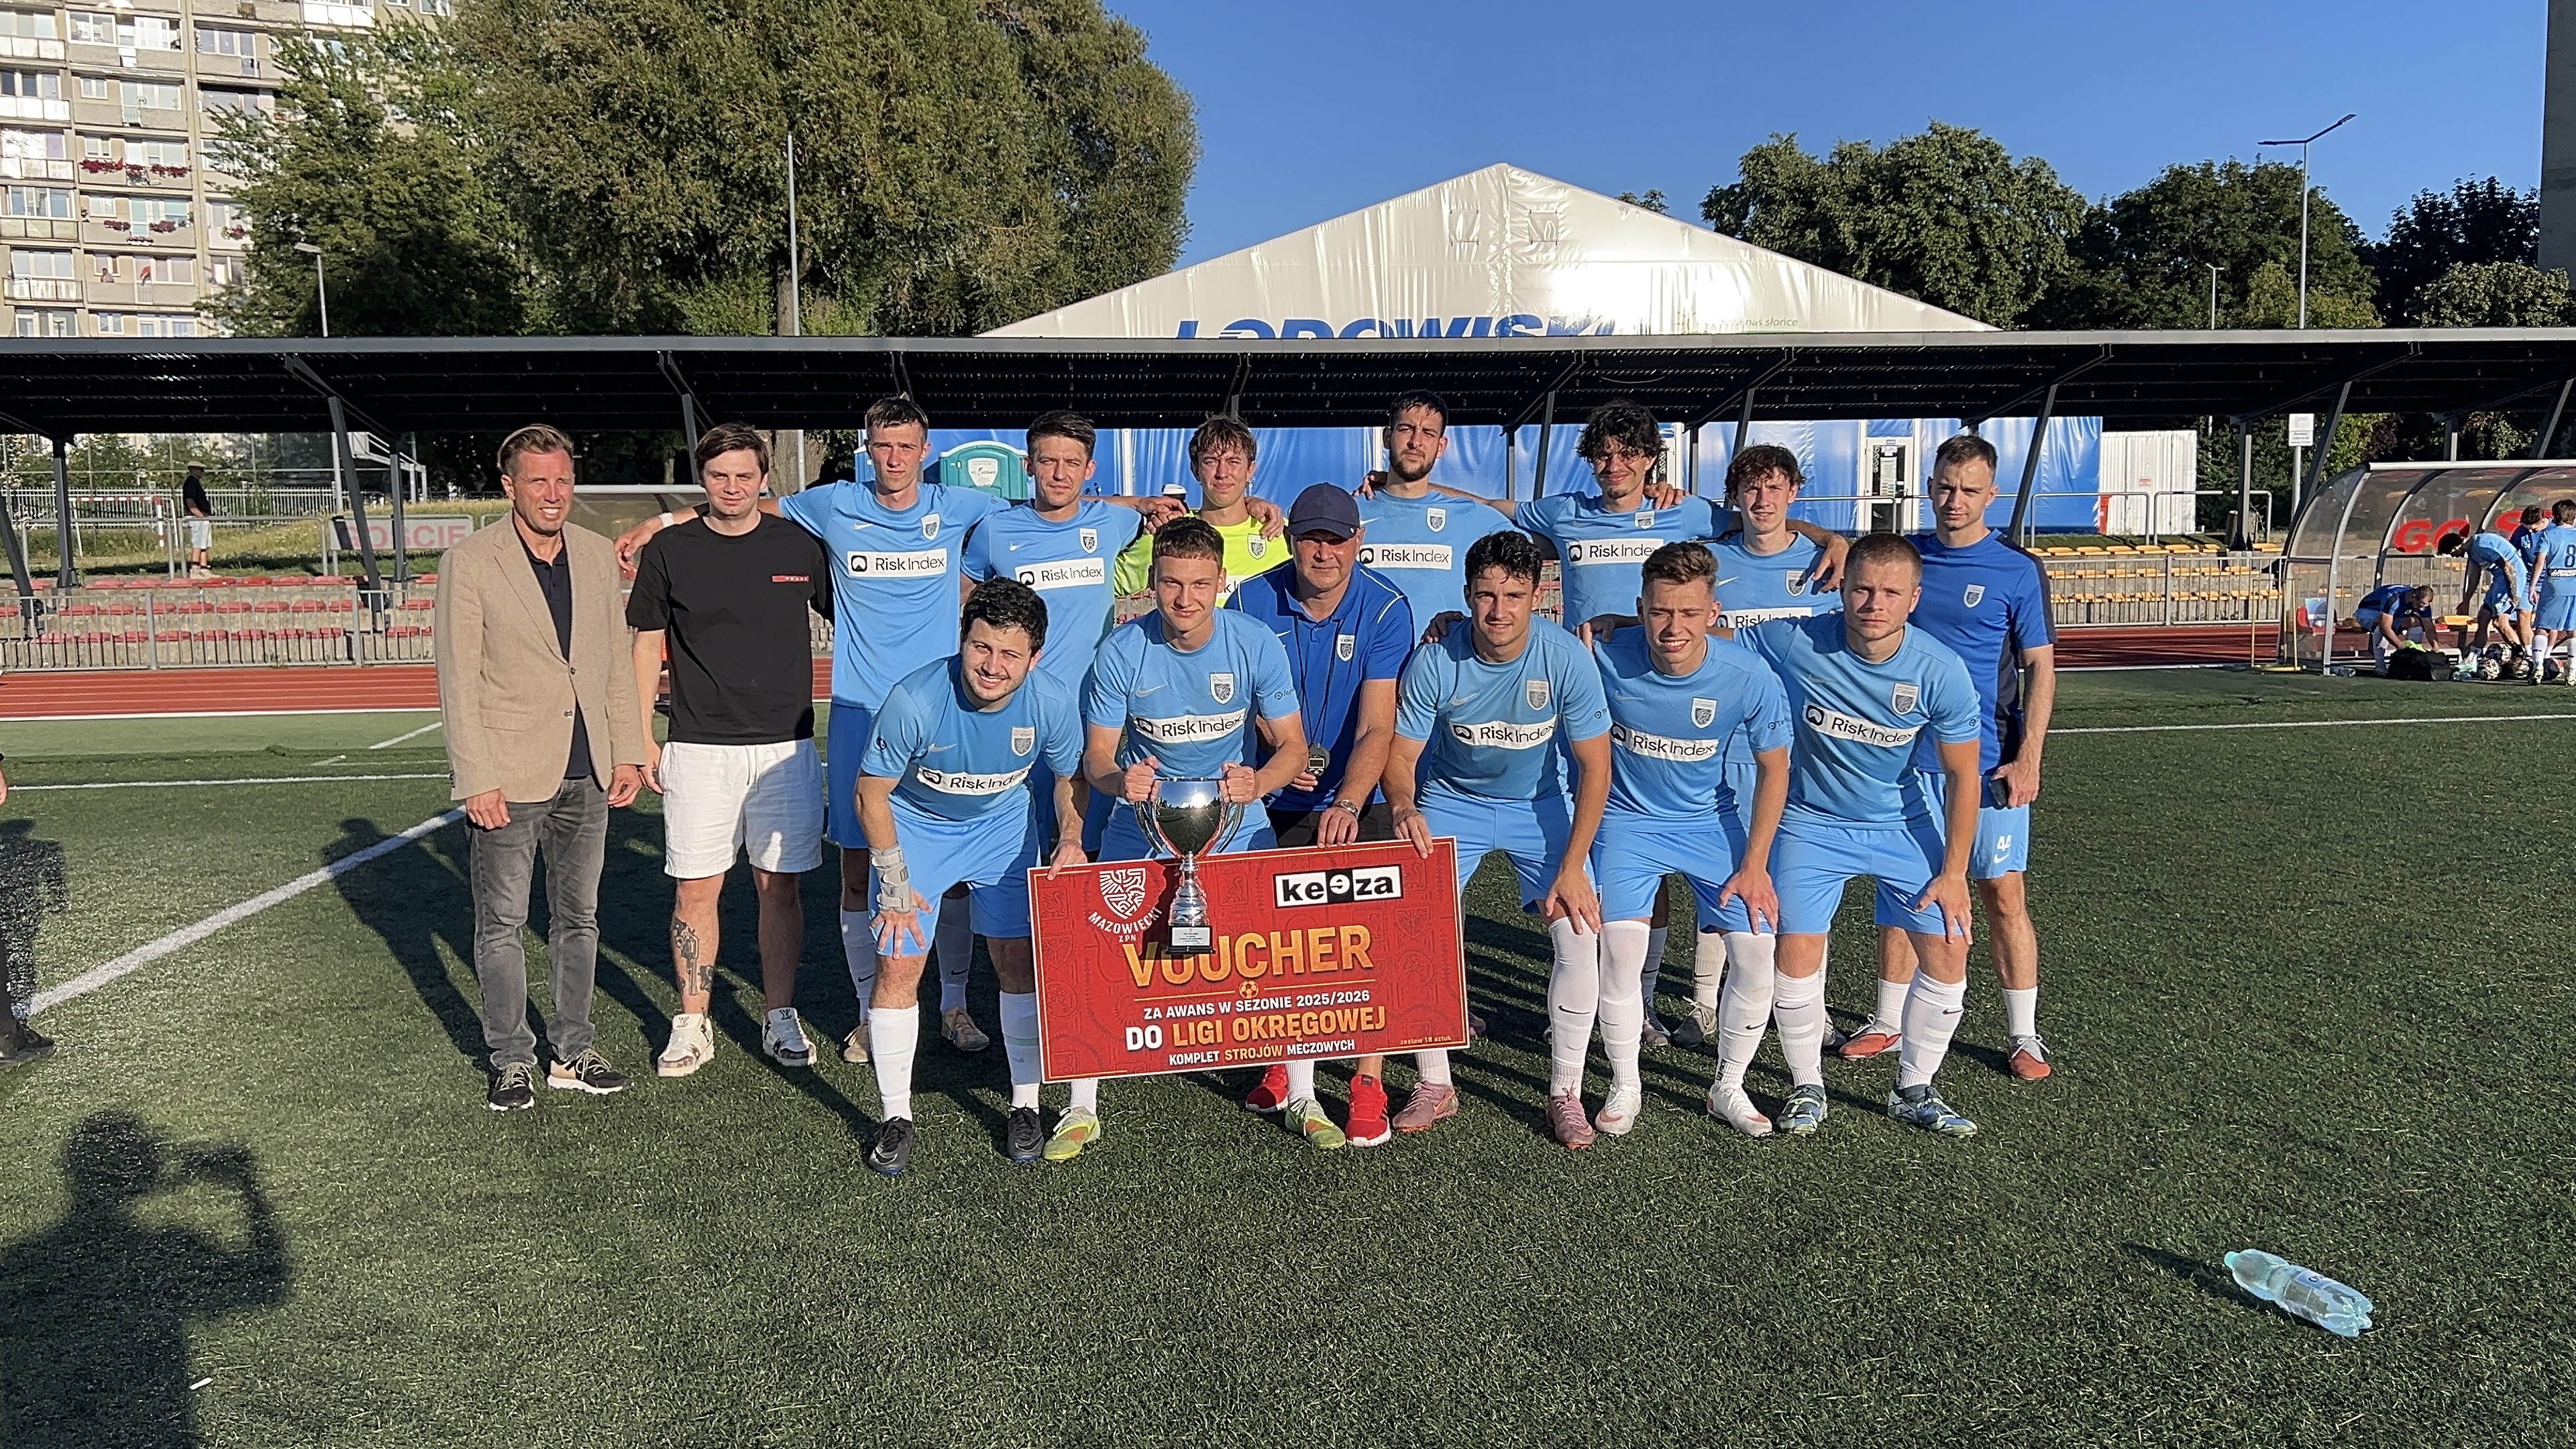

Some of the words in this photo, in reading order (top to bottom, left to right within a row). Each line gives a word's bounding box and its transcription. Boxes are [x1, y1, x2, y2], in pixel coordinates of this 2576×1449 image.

[1088, 907, 1163, 934] MAZOWIECKI
[1118, 934, 1136, 943] ZPN
[1122, 925, 1374, 987] VOUCHER
[1143, 1007, 1163, 1020] ZA
[1166, 1004, 1215, 1018] AWANS
[1218, 1002, 1230, 1014] W
[1235, 998, 1292, 1012] SEZONIE
[1297, 990, 1371, 1008] 2025/2026
[1126, 1025, 1163, 1051] DO
[1172, 1018, 1224, 1046] LIGI
[1233, 1006, 1386, 1042] OKRĘGOWEJ
[1169, 1050, 1220, 1066] KOMPLET
[1224, 1044, 1283, 1062] STROJÓW
[1287, 1039, 1356, 1056] MECZOWYCH
